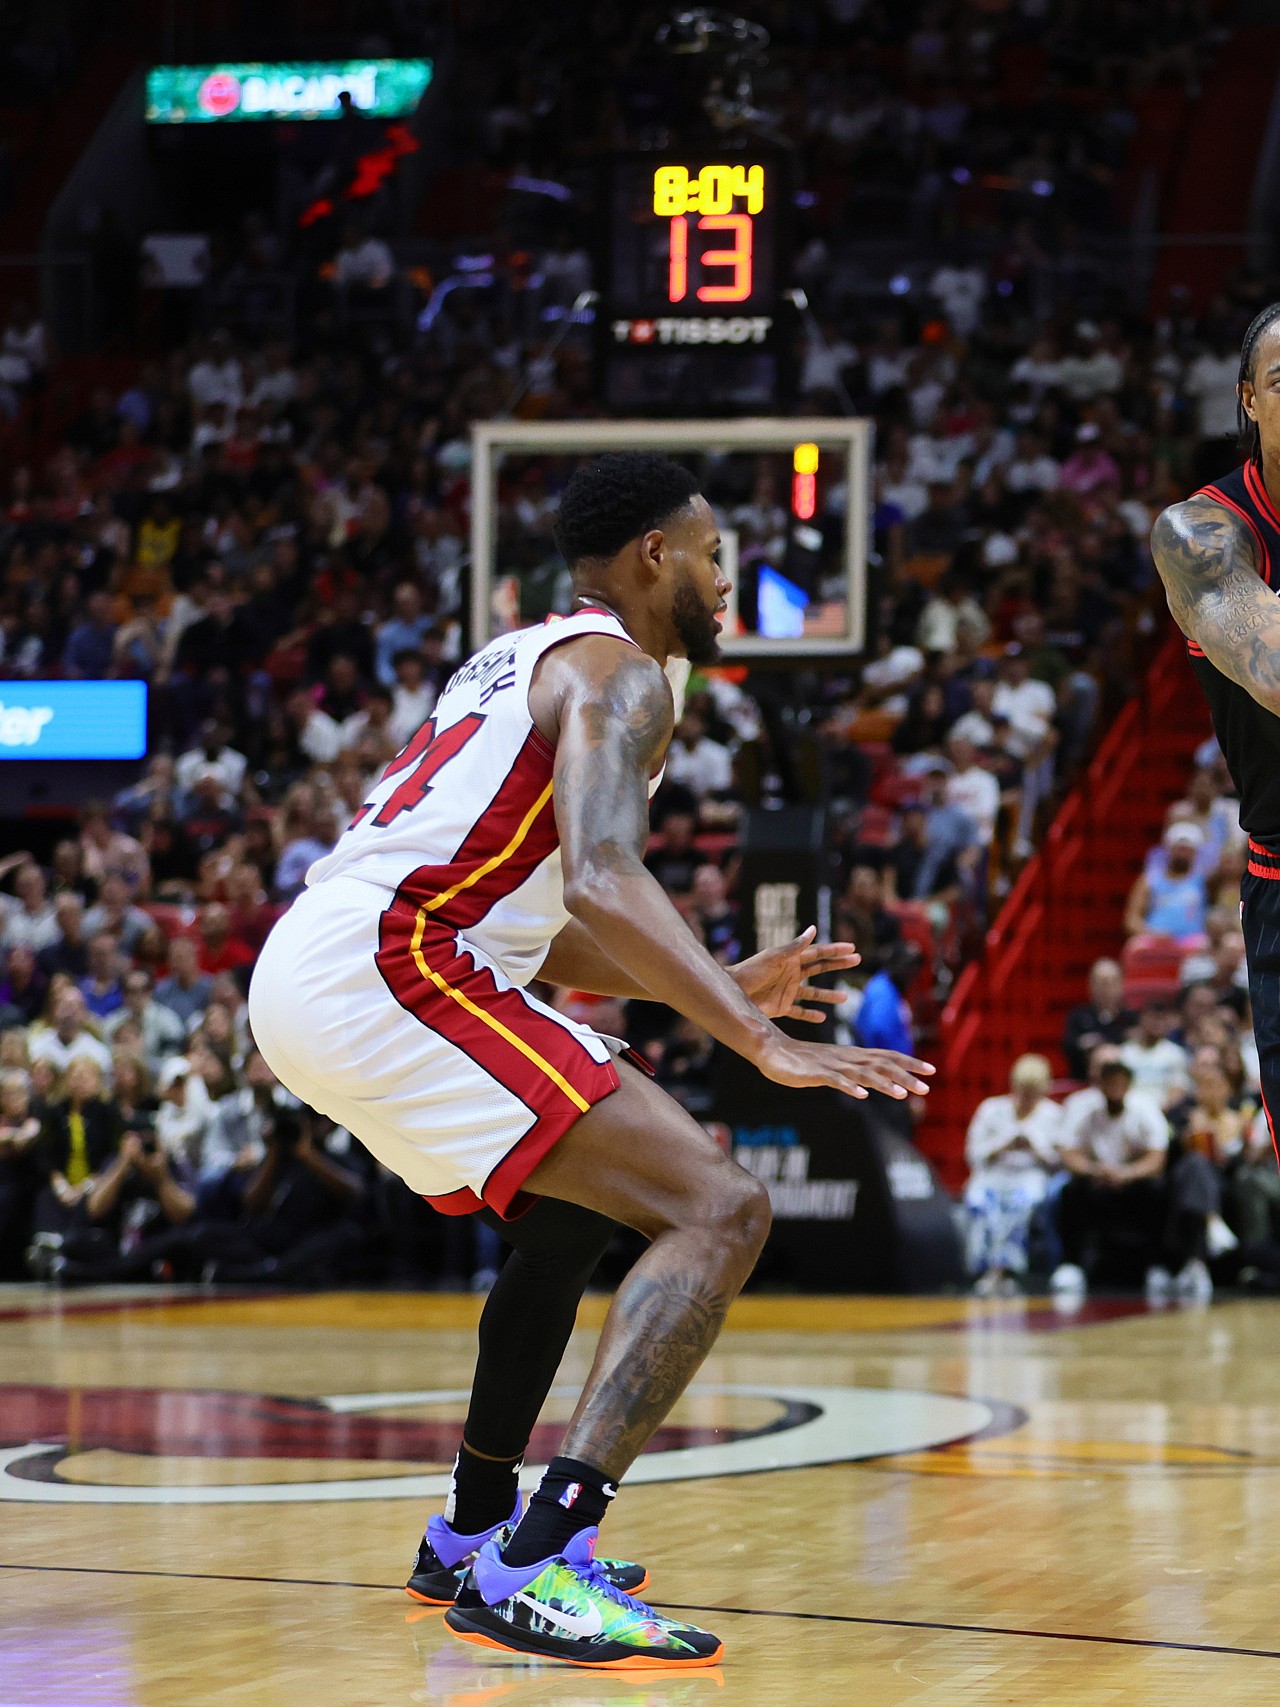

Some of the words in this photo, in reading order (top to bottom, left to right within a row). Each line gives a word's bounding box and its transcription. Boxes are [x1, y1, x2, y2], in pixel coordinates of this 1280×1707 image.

[653, 165, 765, 217] 8:04
[669, 214, 753, 303] 13
[657, 316, 774, 345] TISSOT
